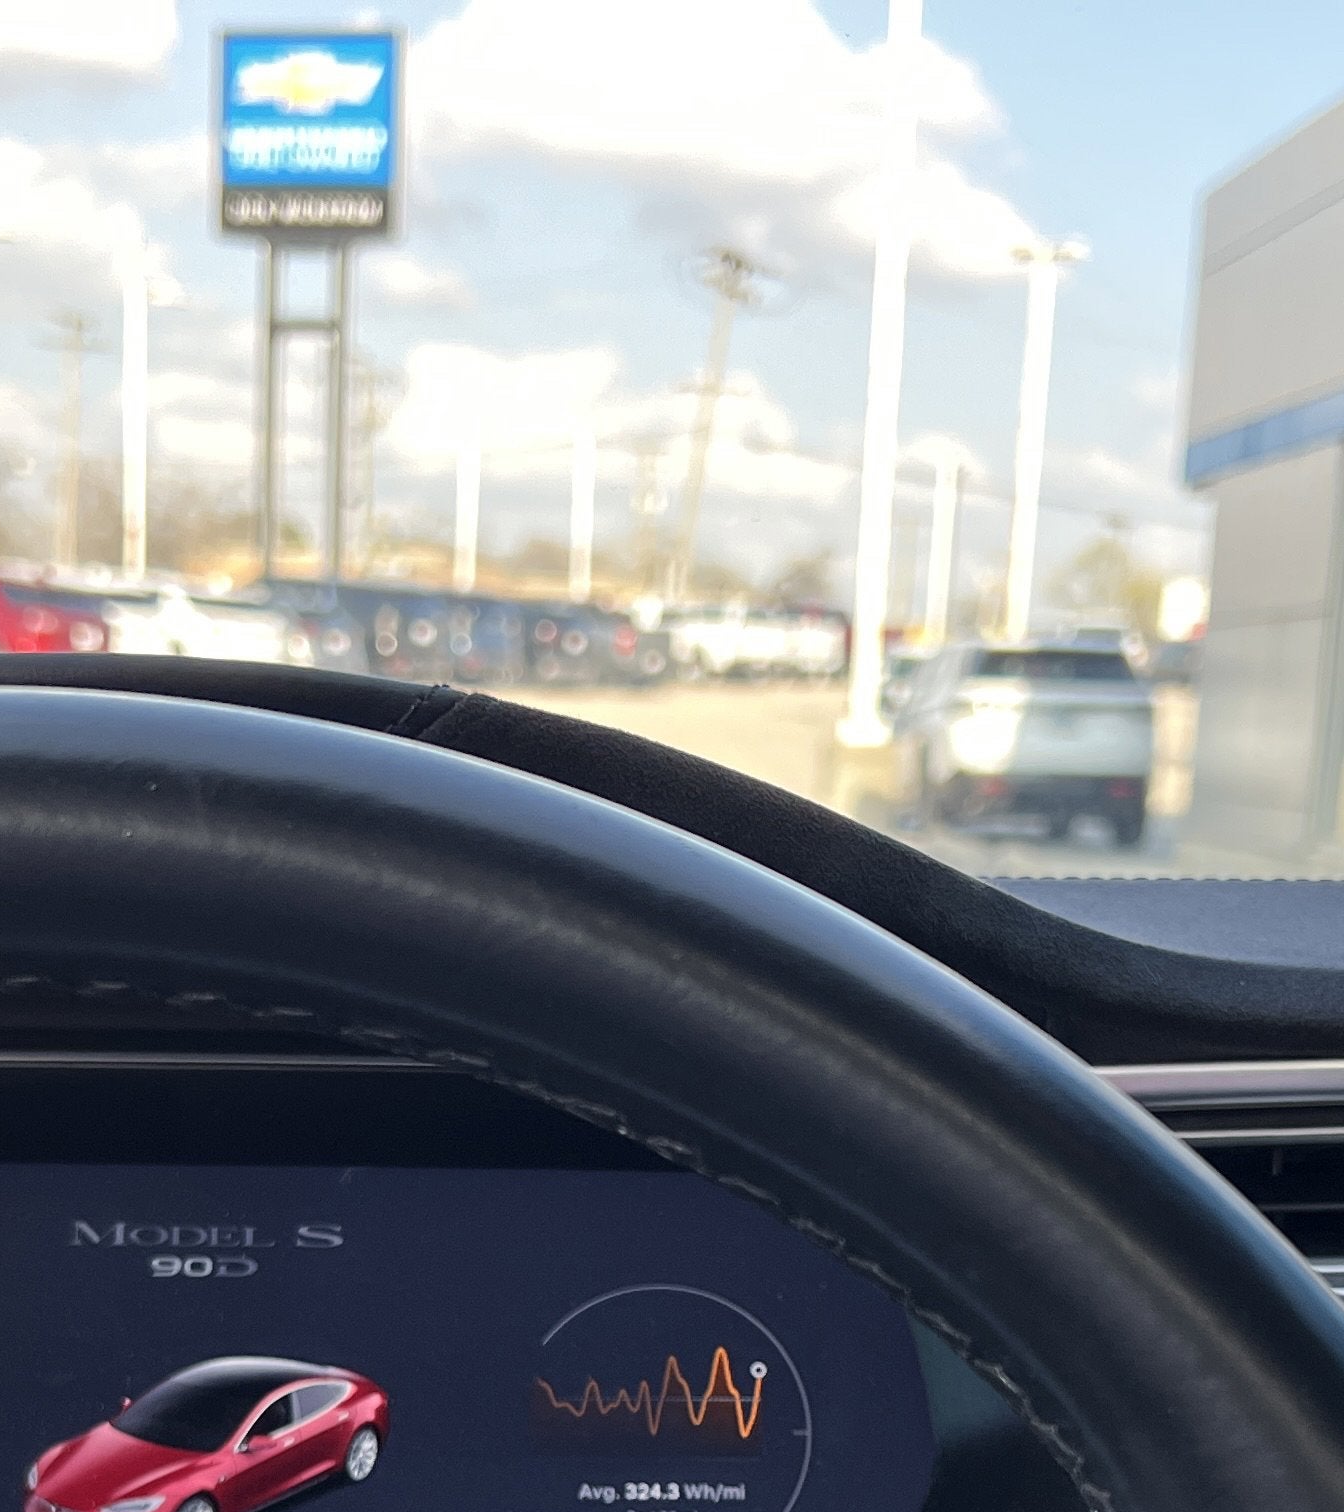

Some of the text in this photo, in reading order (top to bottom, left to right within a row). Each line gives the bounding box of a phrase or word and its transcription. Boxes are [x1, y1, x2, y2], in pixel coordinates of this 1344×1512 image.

[296, 1223, 344, 1249] S
[151, 1255, 258, 1278] 90D
[578, 1481, 747, 1504] Avg. 324.3 Wh/mi
